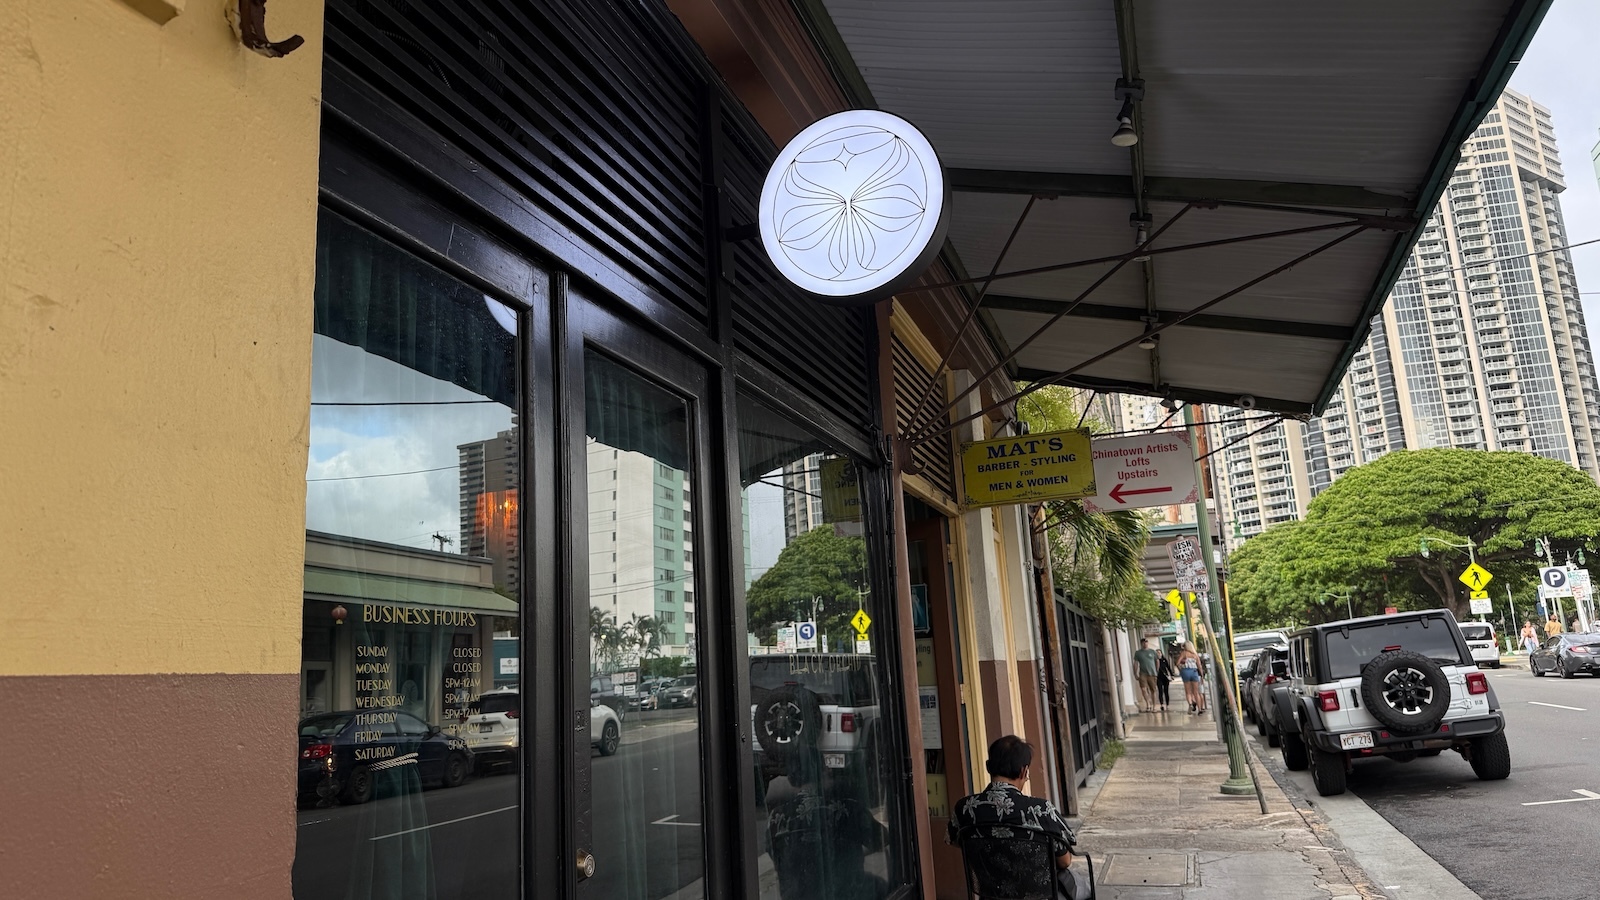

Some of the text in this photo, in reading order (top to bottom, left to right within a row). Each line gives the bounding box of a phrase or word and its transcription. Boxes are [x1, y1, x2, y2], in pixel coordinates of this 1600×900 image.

[986, 437, 1063, 459] MAT'S
[1092, 443, 1178, 460] Chinatown Artists
[977, 460, 1020, 473] BARBER
[1030, 453, 1076, 467] STYLING
[1125, 457, 1150, 467] Lofts
[1020, 469, 1034, 477] FOR
[1117, 468, 1158, 481] Upstairs
[989, 475, 1068, 492] MEN & WOMEN
[363, 604, 477, 627] BUSINESS HOURS
[357, 646, 389, 657] SUNDAY
[453, 647, 482, 658] CLOSED
[355, 662, 391, 674] MONDAY
[453, 662, 482, 673] CLOSED
[789, 654, 824, 674] BLACK
[356, 679, 393, 692] TUESDAY
[445, 677, 481, 689] 5PM-12AM
[355, 695, 406, 708] WEDNESDAY
[444, 693, 481, 704] 5PM-12AM
[355, 711, 399, 726] THURSDAY
[444, 707, 481, 720] 5PM-12AM
[354, 729, 384, 743] FRIDAY
[1358, 735, 1372, 745] 273
[354, 745, 397, 761] SATURDAY
